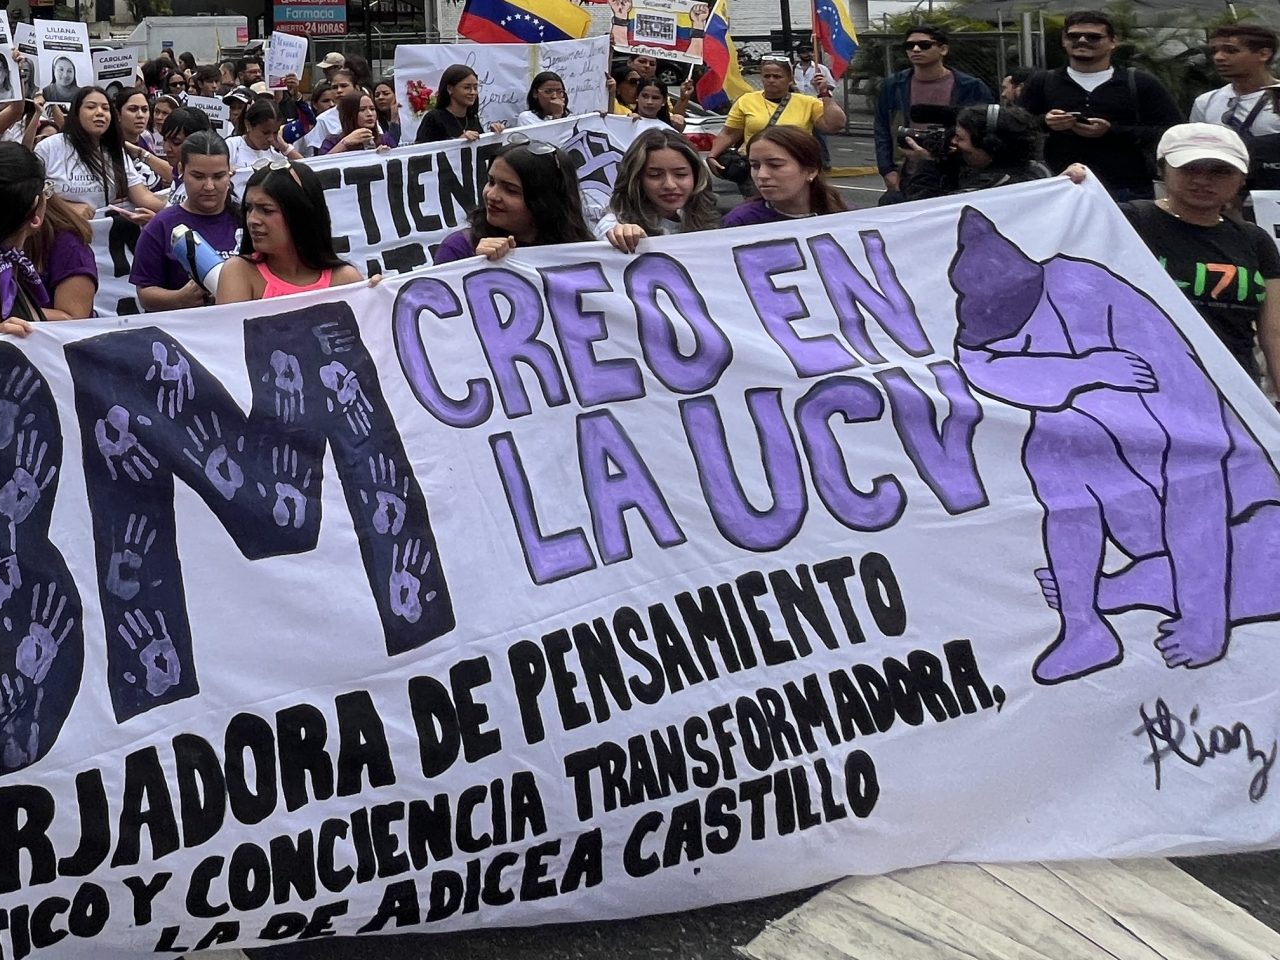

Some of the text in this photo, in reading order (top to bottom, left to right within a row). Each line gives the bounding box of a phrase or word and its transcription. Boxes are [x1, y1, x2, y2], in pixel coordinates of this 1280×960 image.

[46, 27, 77, 35] LILIANA
[99, 54, 133, 64] CAROLINA
[286, 7, 335, 19] Farmacia
[305, 22, 317, 34] 24
[318, 22, 345, 33] HORAS
[194, 102, 223, 112] YOLIMAR
[392, 229, 934, 429] CREO EN
[488, 359, 991, 587] LA UCV
[408, 654, 503, 779] DE
[508, 551, 908, 745] PENSAMIENTO
[122, 872, 173, 927] Y
[185, 771, 550, 919] CONCIENCIA
[564, 638, 1007, 822] TRANSFORMADORA,
[154, 749, 881, 953] LA DE ADICEA CASTILLO
